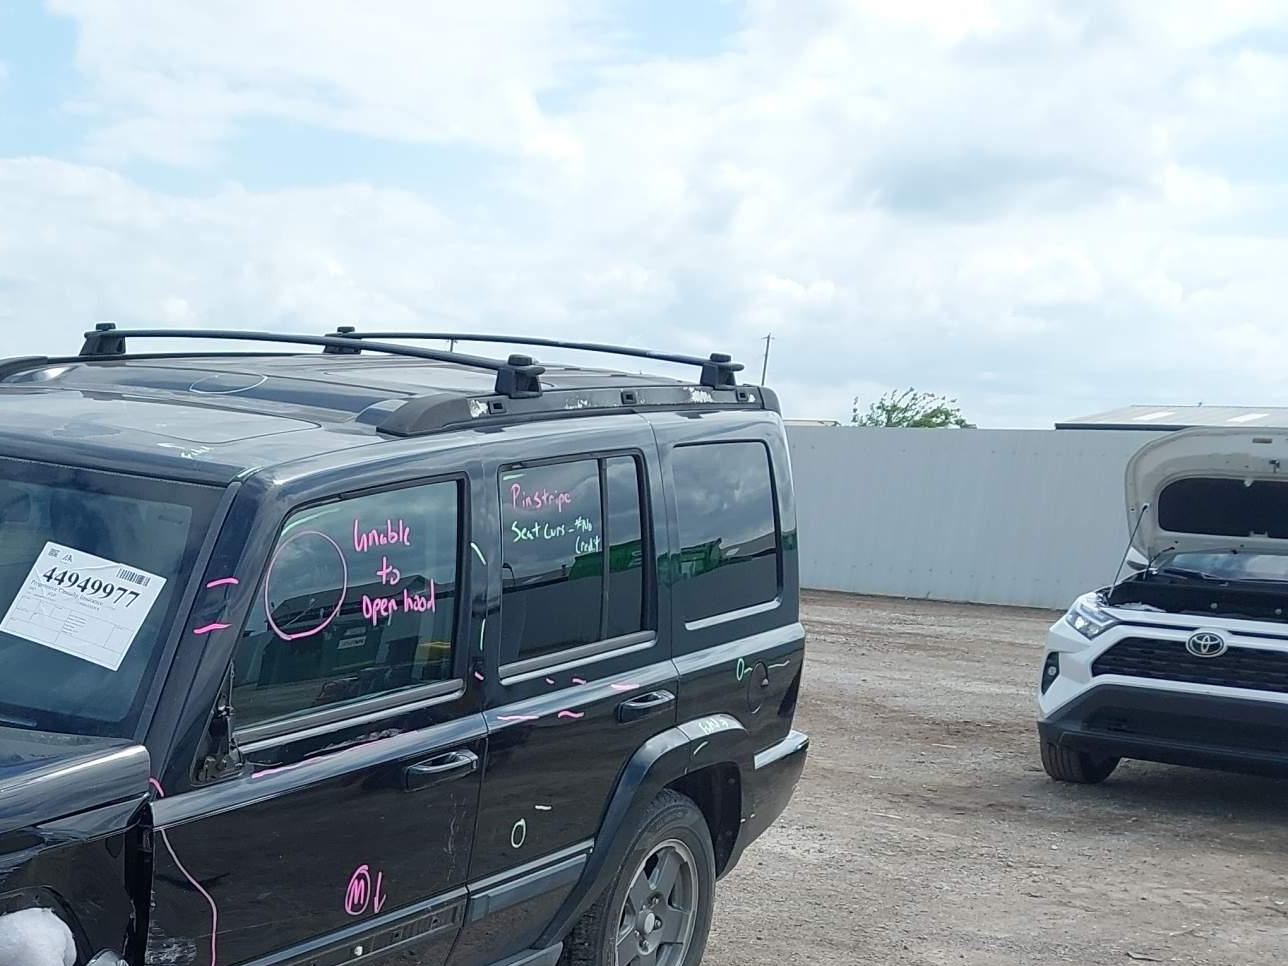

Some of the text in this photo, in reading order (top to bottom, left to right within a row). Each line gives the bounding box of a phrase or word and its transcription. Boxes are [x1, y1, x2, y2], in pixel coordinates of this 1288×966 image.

[511, 483, 573, 512] Pinstripe
[354, 519, 411, 552] Unable
[511, 521, 541, 543] Seat
[376, 556, 401, 585] to
[42, 566, 140, 609] 44949977
[403, 578, 436, 613] hood
